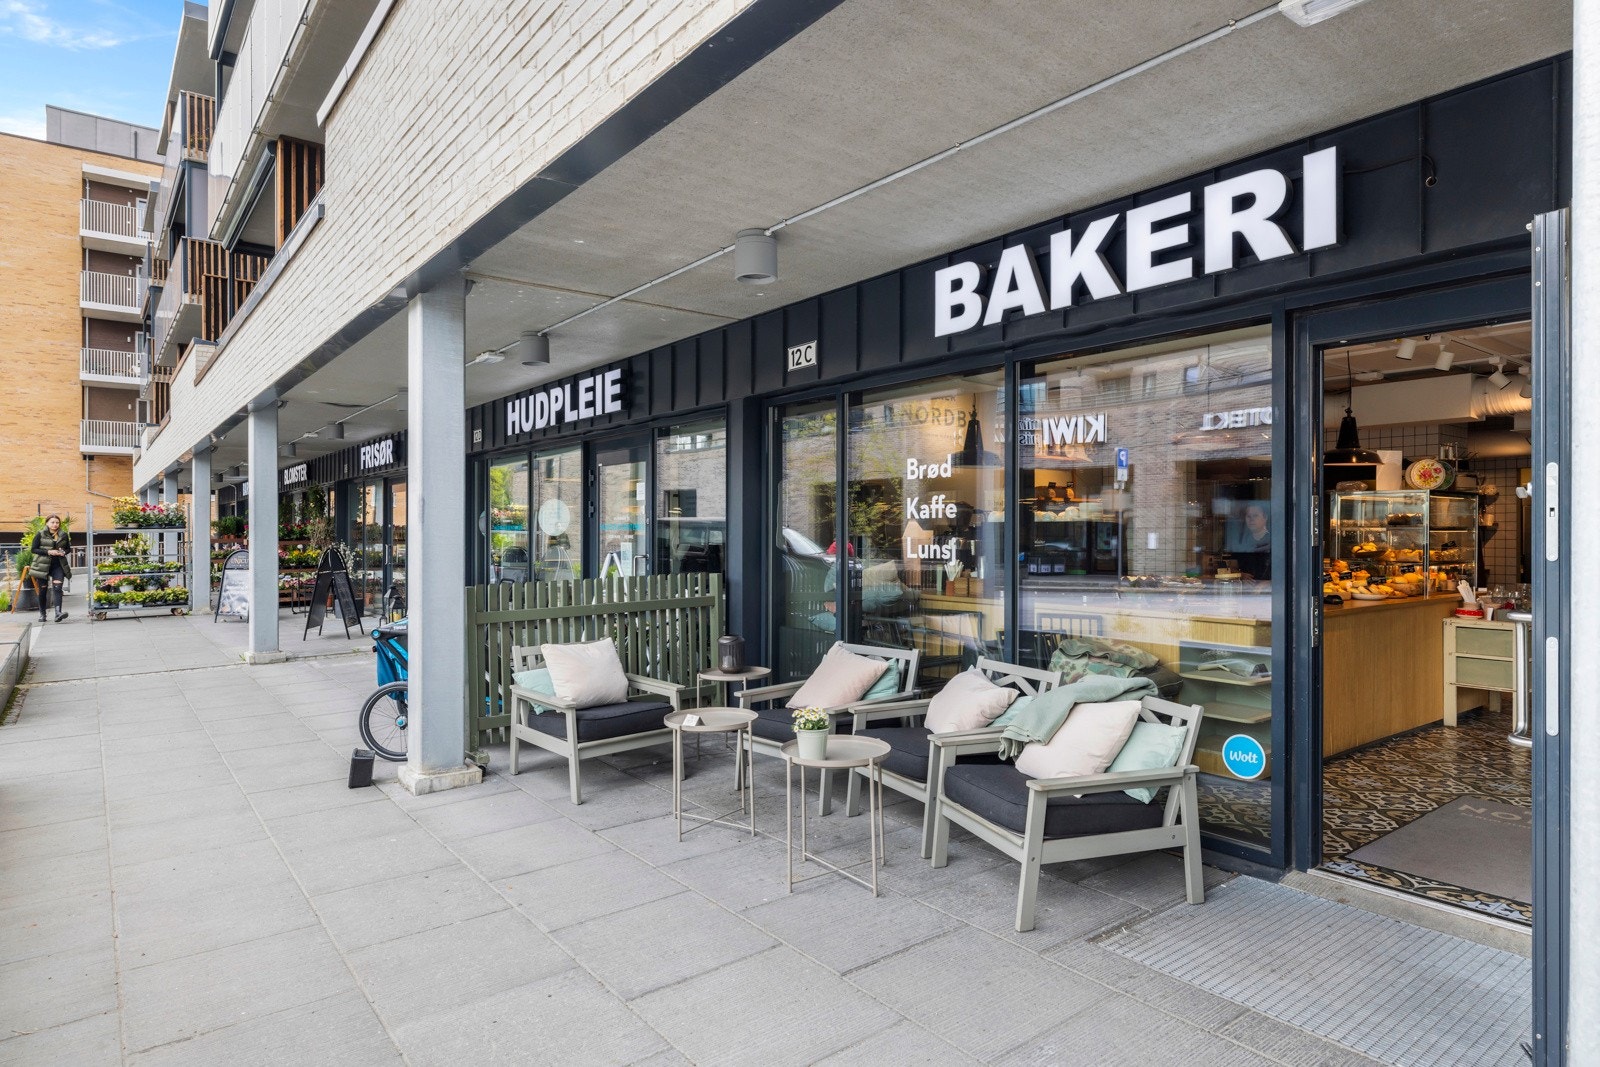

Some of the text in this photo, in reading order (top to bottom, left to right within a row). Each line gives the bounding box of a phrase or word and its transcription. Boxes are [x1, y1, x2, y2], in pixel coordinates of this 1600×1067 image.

[934, 145, 1337, 338] BAKERI
[791, 345, 812, 366] 12 C
[507, 368, 622, 436] HUDPLEIE
[360, 439, 393, 470] FRISØR
[906, 454, 952, 480] Brød
[284, 463, 307, 486] BLOMSTER
[906, 494, 958, 519] Kaffe
[906, 537, 957, 566] Lunsj
[1230, 750, 1258, 764] Wolt
